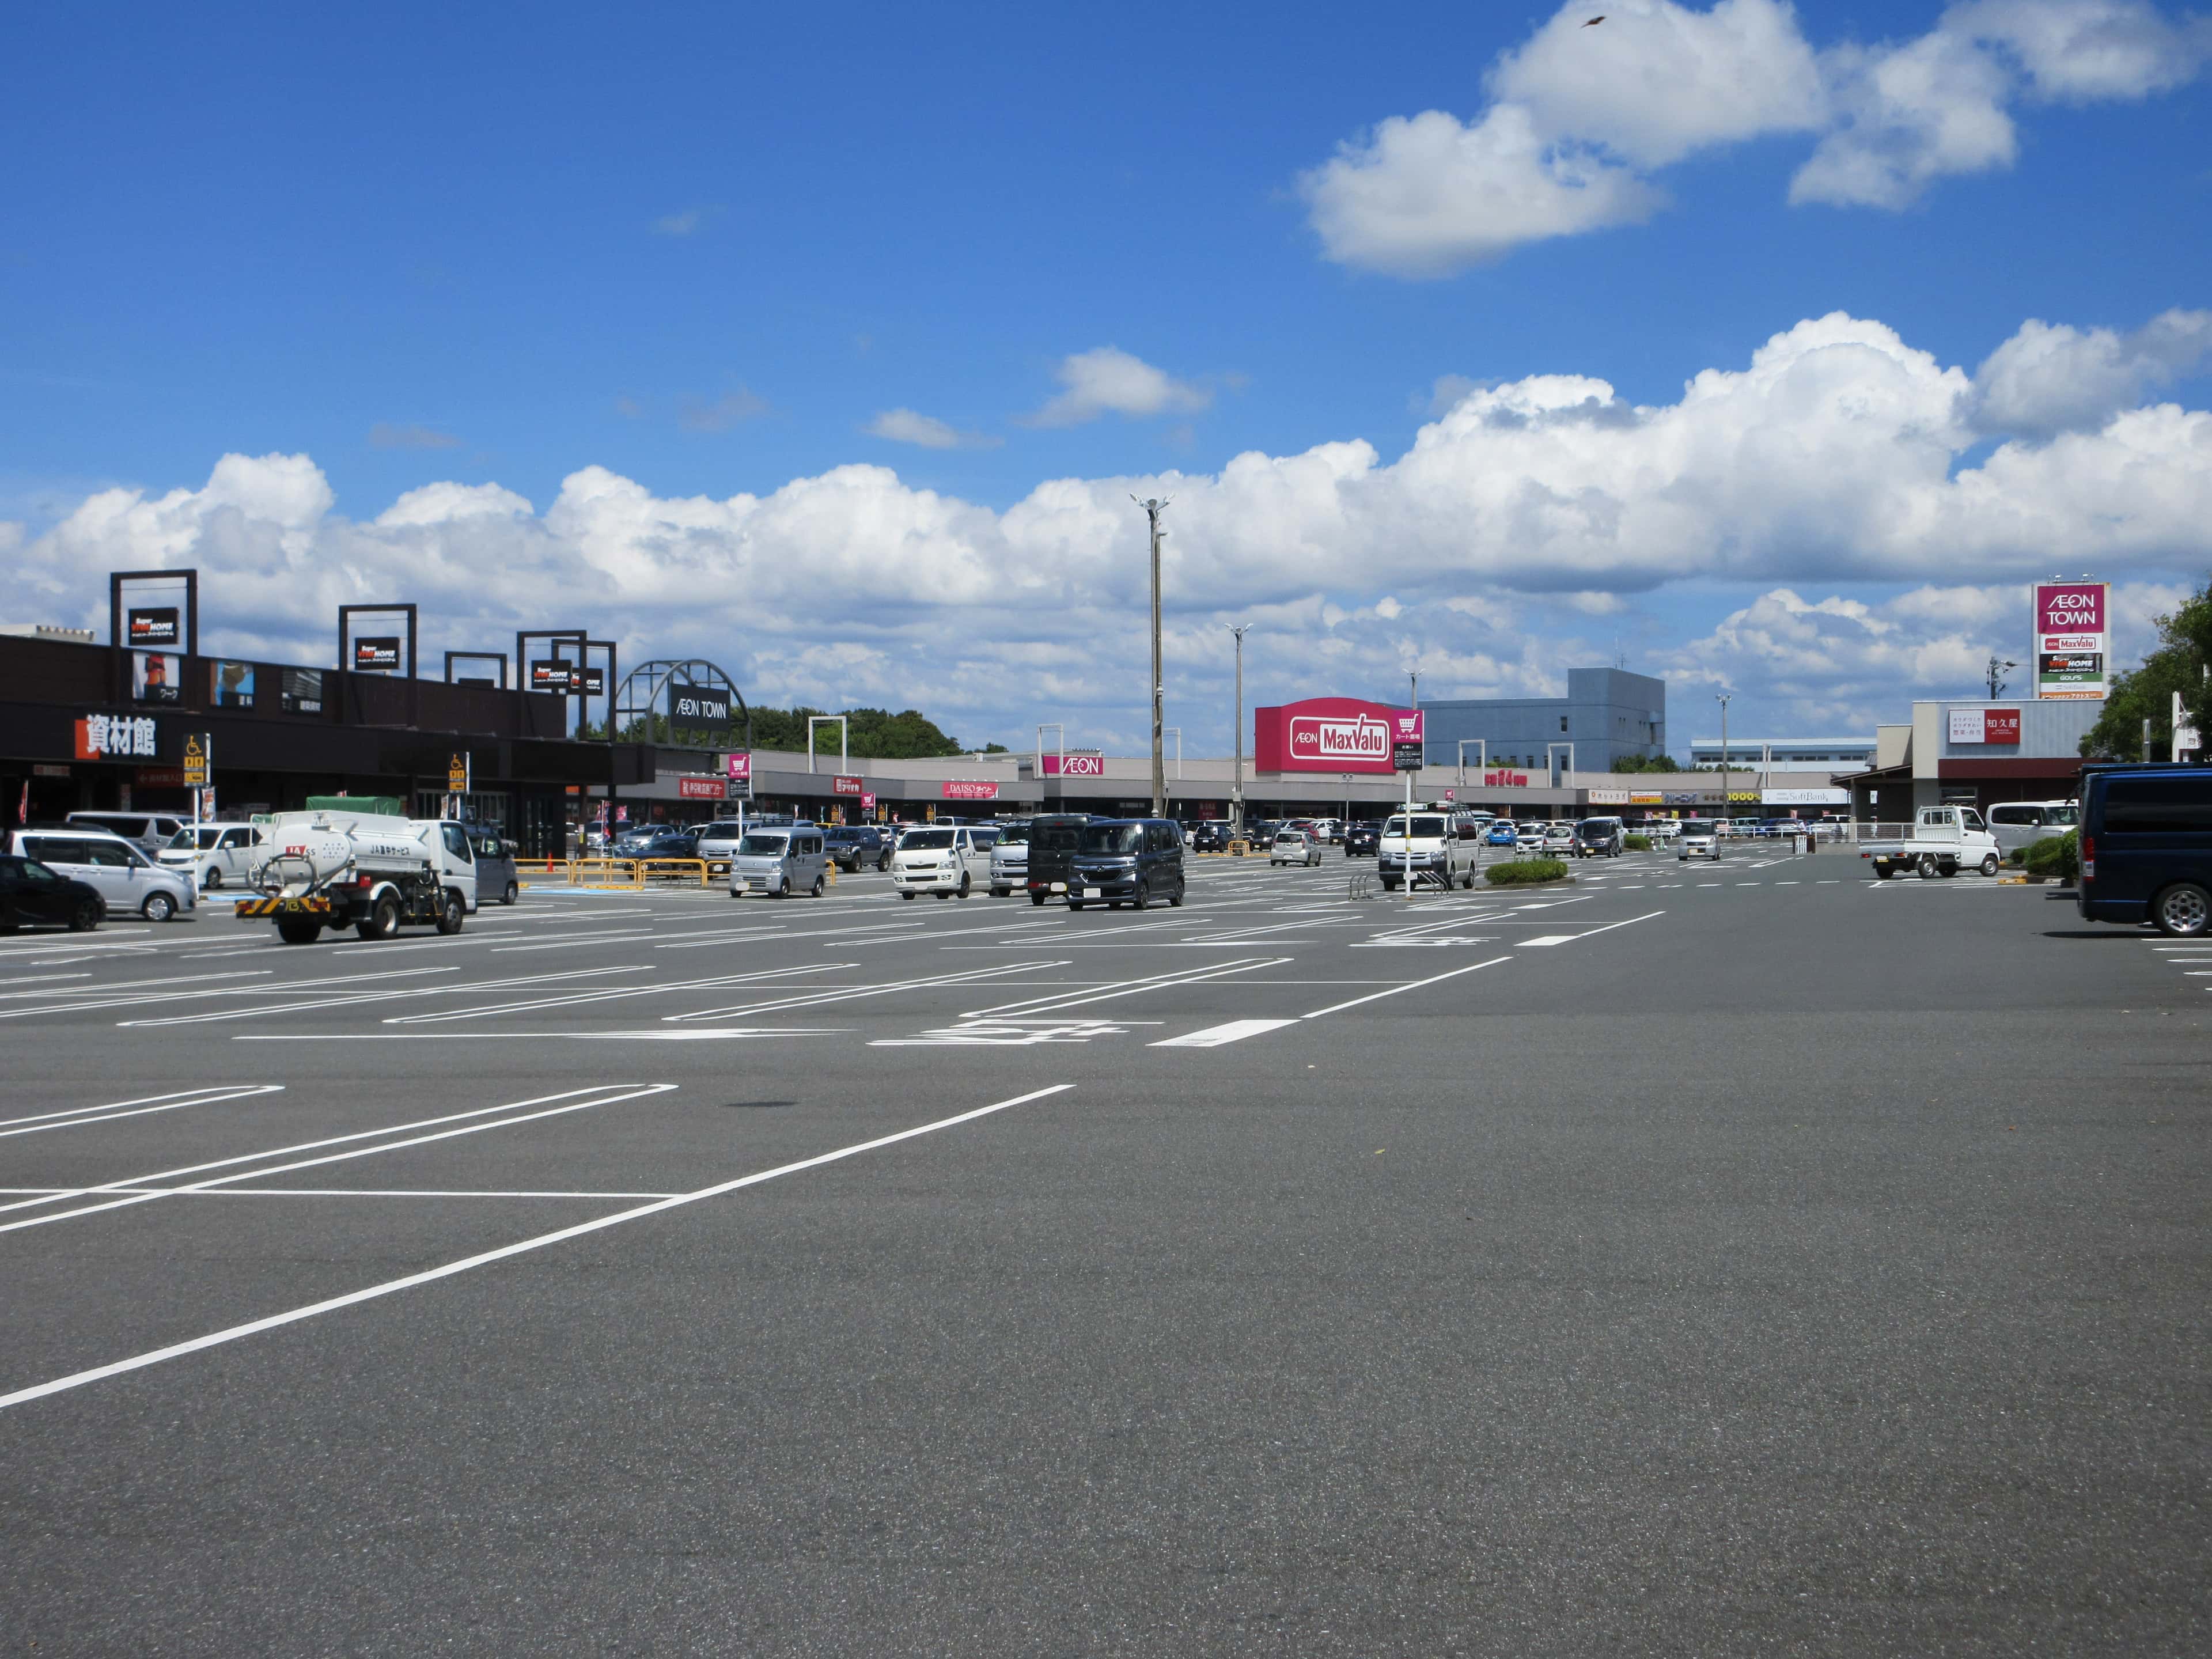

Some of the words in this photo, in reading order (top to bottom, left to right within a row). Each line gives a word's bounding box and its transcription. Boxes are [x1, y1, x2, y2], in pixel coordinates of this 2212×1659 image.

[2047, 611, 2095, 625] TOWN
[2061, 636, 2093, 647] MaxValu
[702, 701, 726, 719] TOWN
[1987, 719, 2018, 728] 知久屋
[87, 714, 156, 755] 資材館
[1324, 716, 1382, 751] MaxValu
[950, 784, 975, 792] DAISO
[1789, 791, 1828, 801] SoftBank
